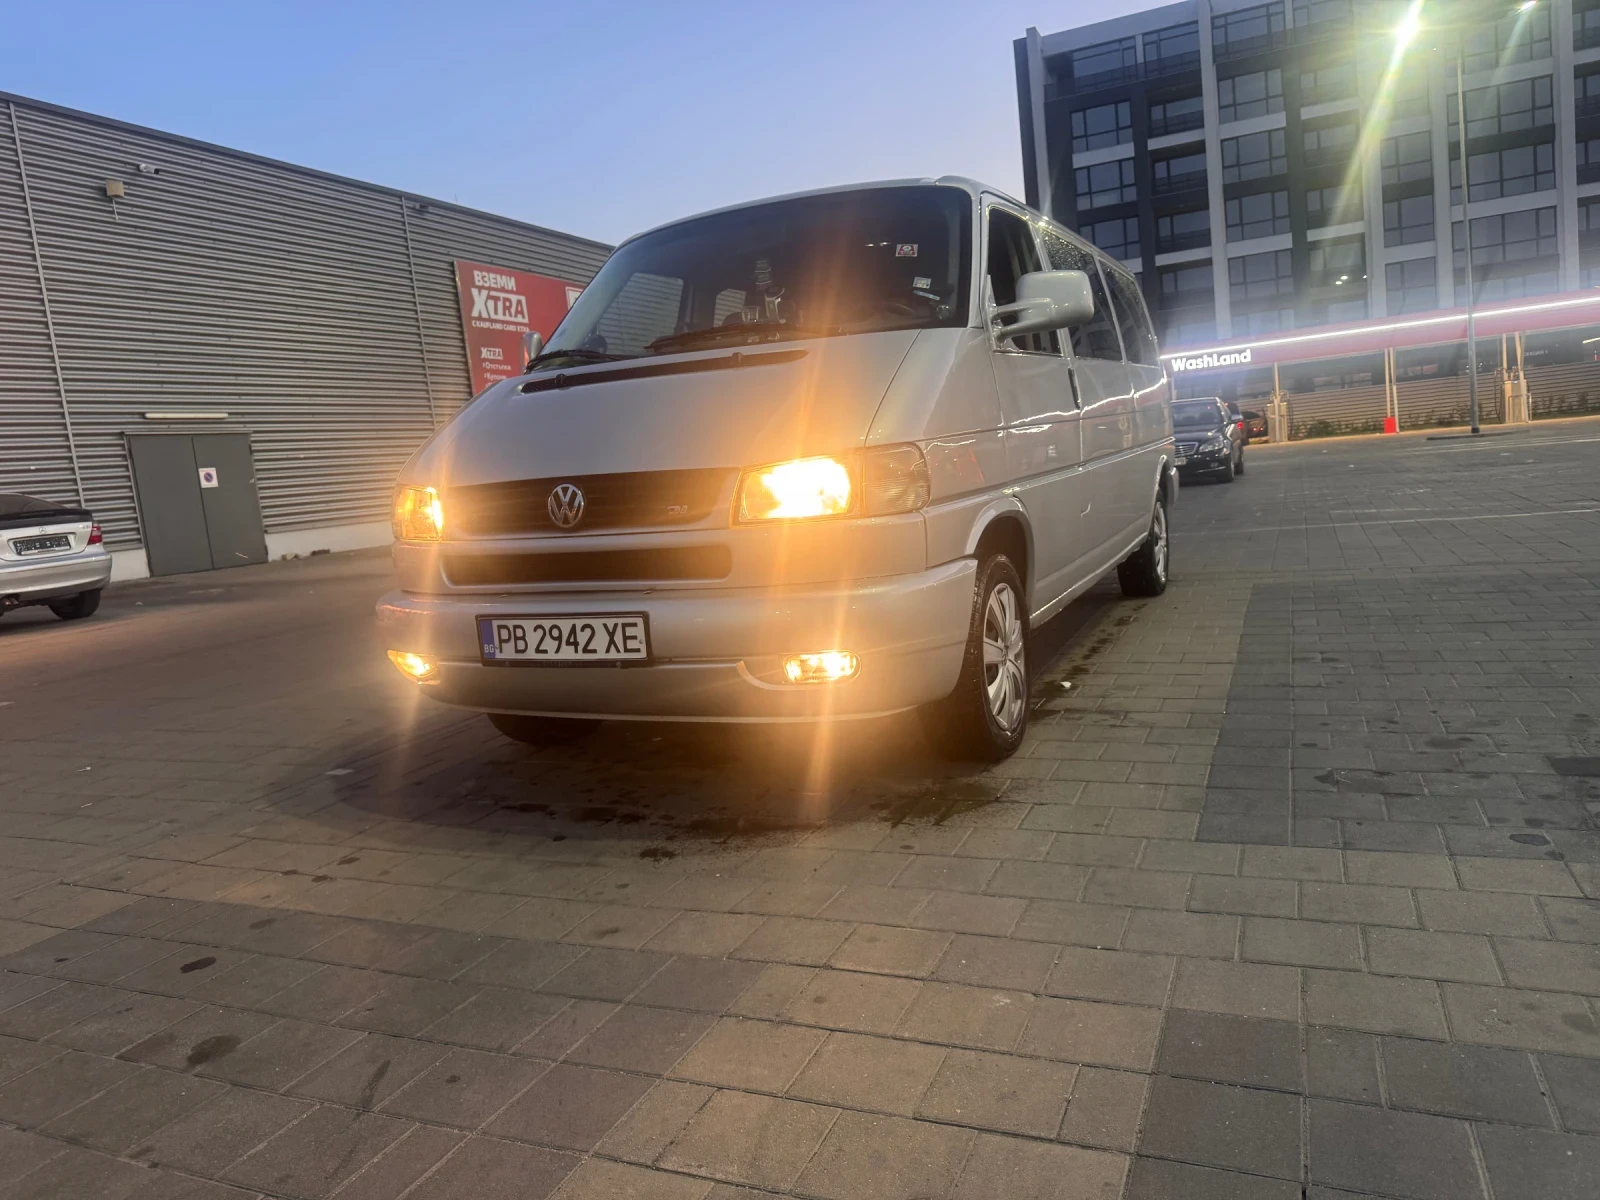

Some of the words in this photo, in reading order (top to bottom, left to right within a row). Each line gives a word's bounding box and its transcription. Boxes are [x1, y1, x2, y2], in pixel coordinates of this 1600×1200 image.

[473, 270, 517, 292] ВЗЕМИ
[471, 288, 529, 324] XTRA
[503, 324, 517, 332] CARD
[481, 347, 503, 360] XTRA
[1171, 349, 1251, 371] WashLand
[484, 644, 495, 653] BG
[496, 624, 529, 654] PB
[533, 622, 598, 655] 2942
[602, 622, 641, 654] XE
